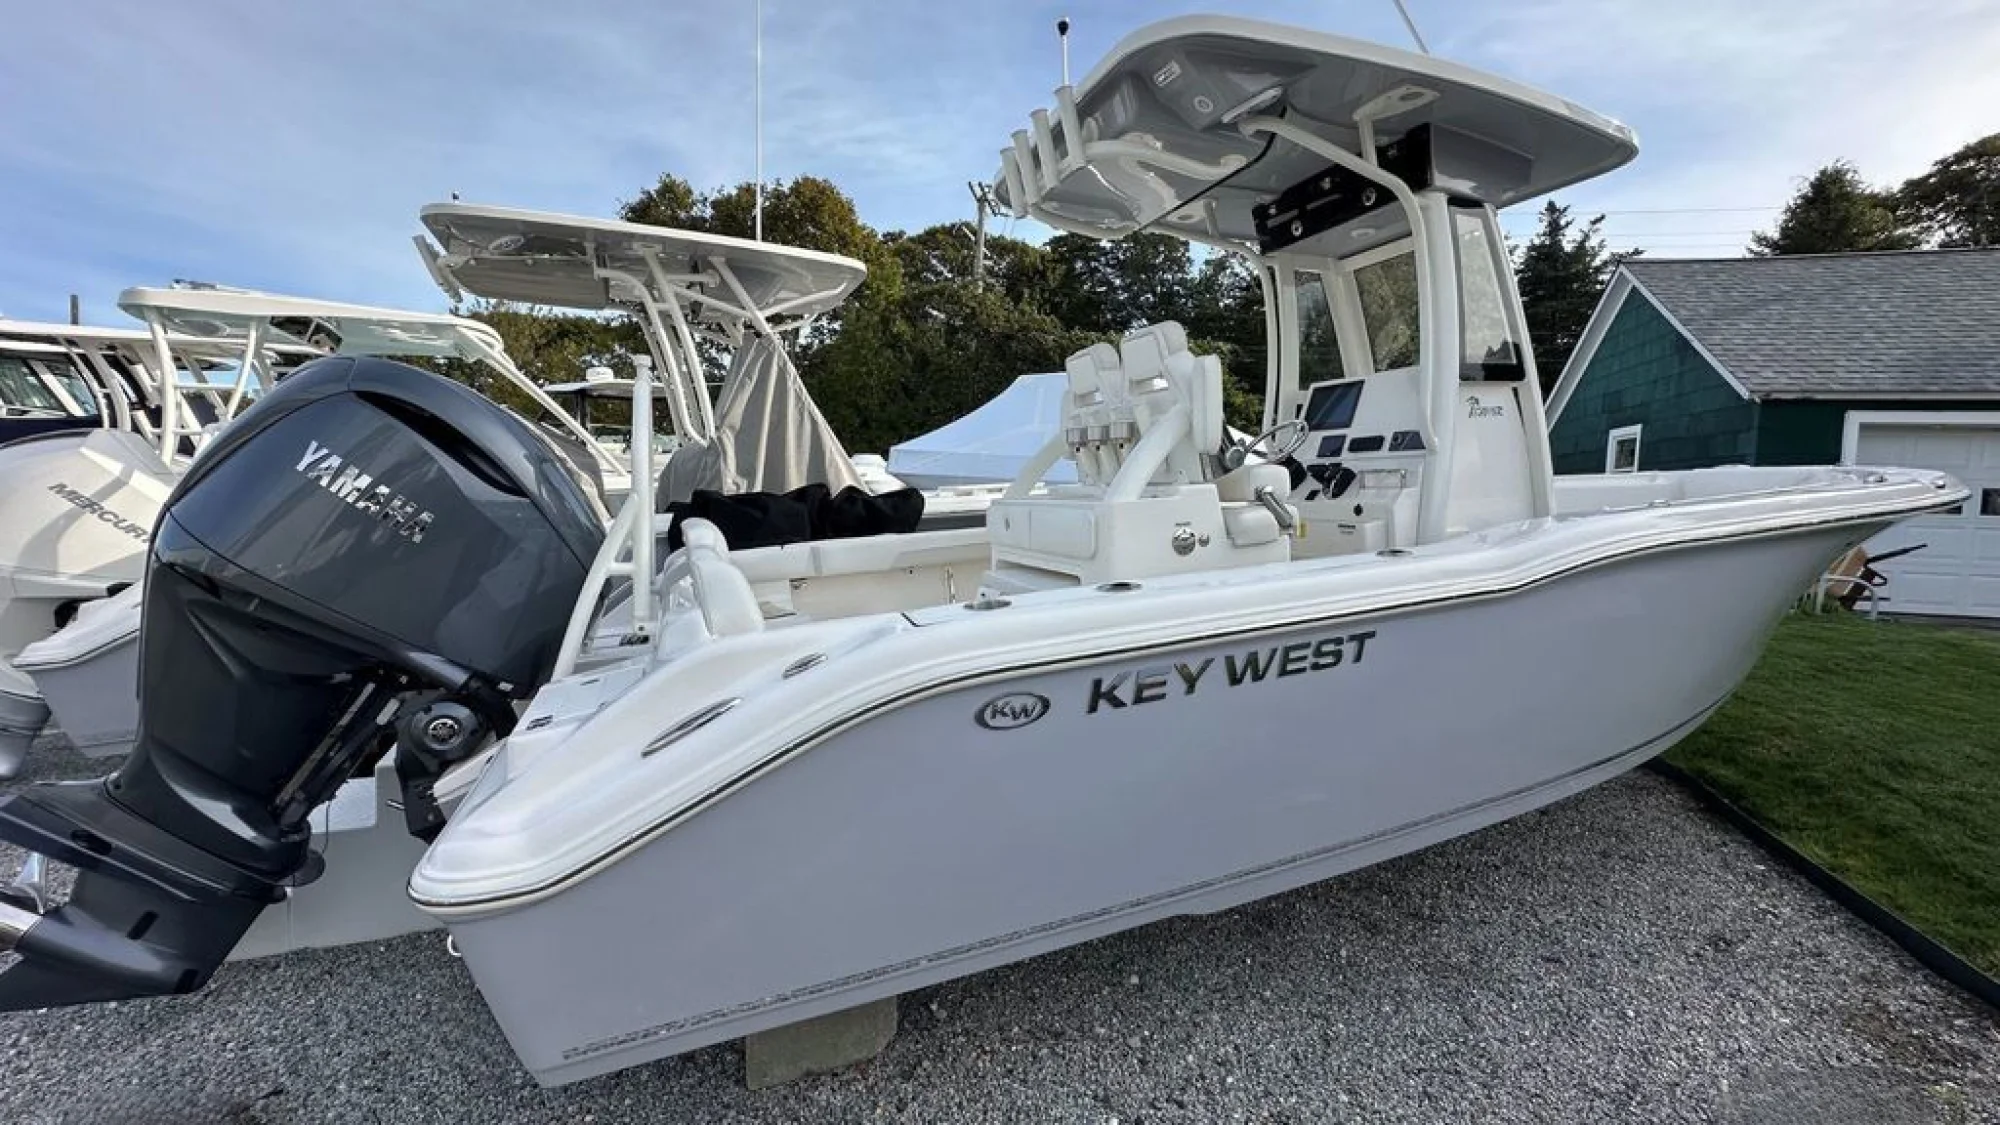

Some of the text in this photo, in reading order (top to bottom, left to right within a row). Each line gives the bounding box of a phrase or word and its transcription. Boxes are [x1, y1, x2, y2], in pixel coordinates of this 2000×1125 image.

[296, 440, 435, 544] YAMAHA
[988, 699, 1041, 721] KW
[1086, 630, 1376, 714] KEY WEST
